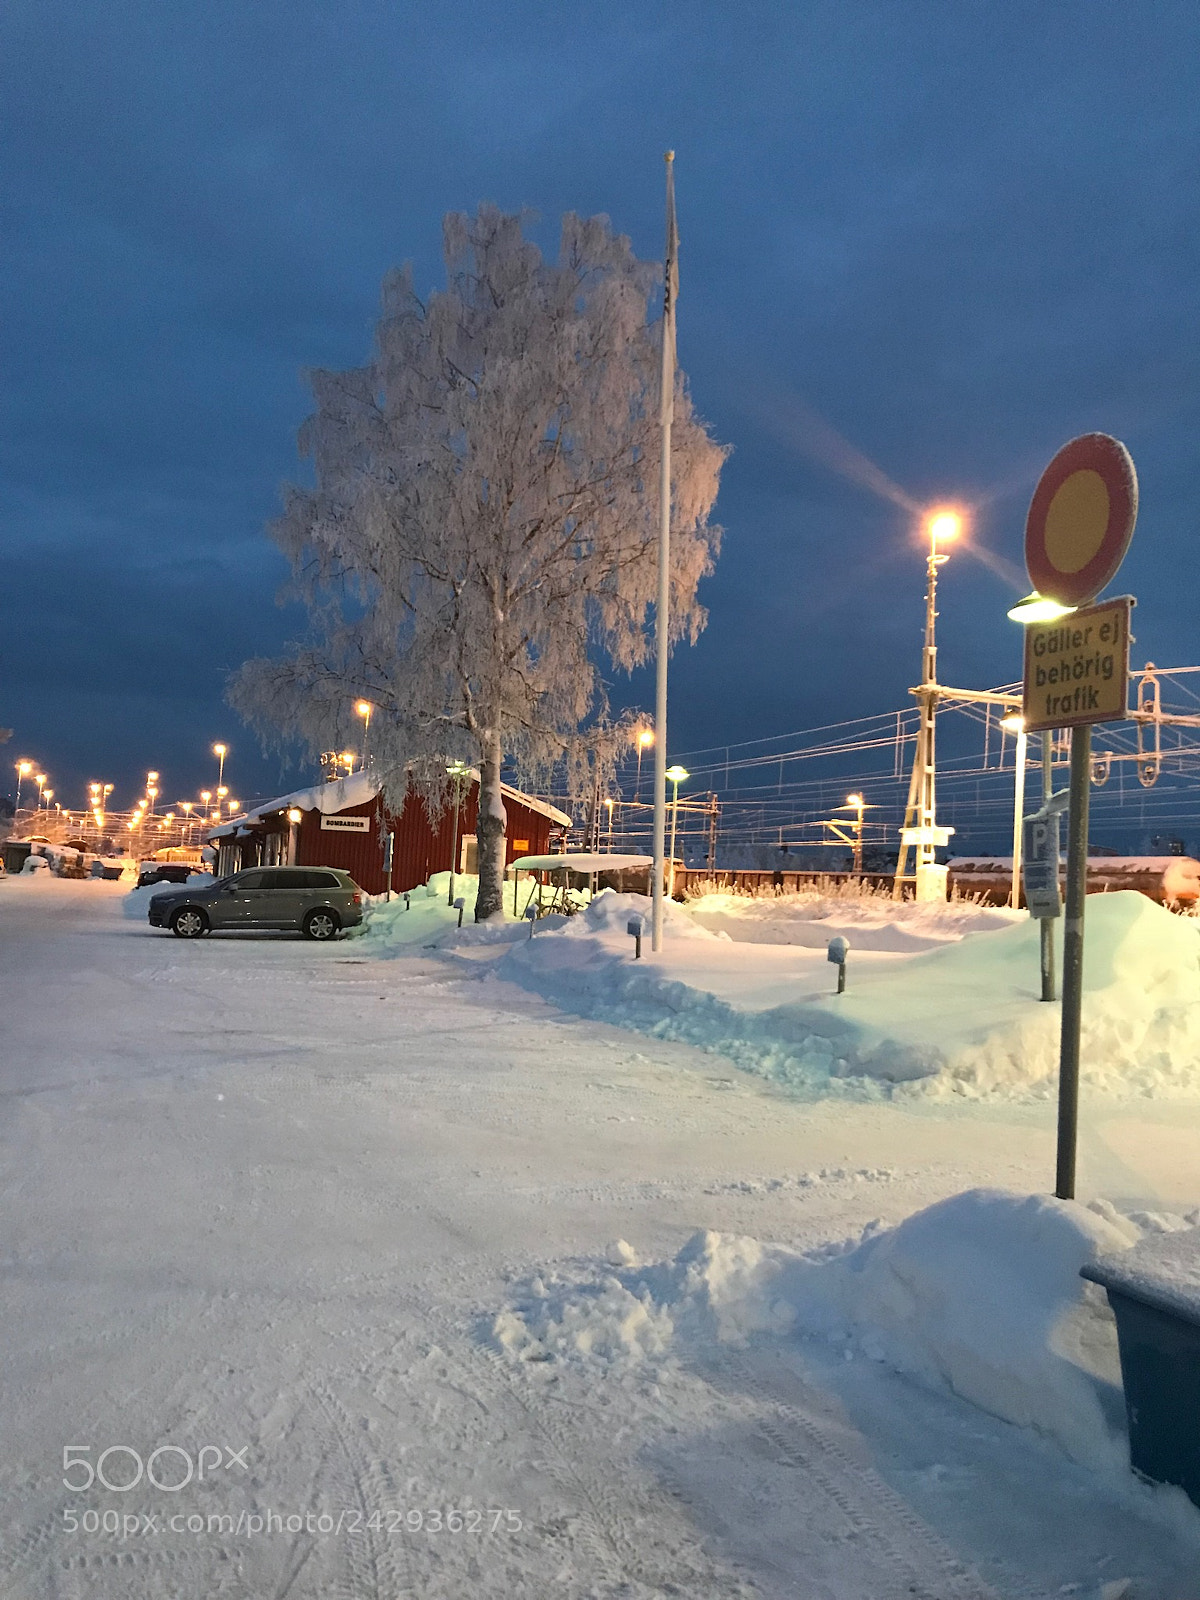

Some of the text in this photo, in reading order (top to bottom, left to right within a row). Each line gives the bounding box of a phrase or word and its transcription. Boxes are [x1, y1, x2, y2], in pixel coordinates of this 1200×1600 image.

[1033, 614, 1119, 656] Gäller ej
[1035, 651, 1113, 687] behörig
[1046, 685, 1099, 715] trafik
[1032, 823, 1048, 858] P
